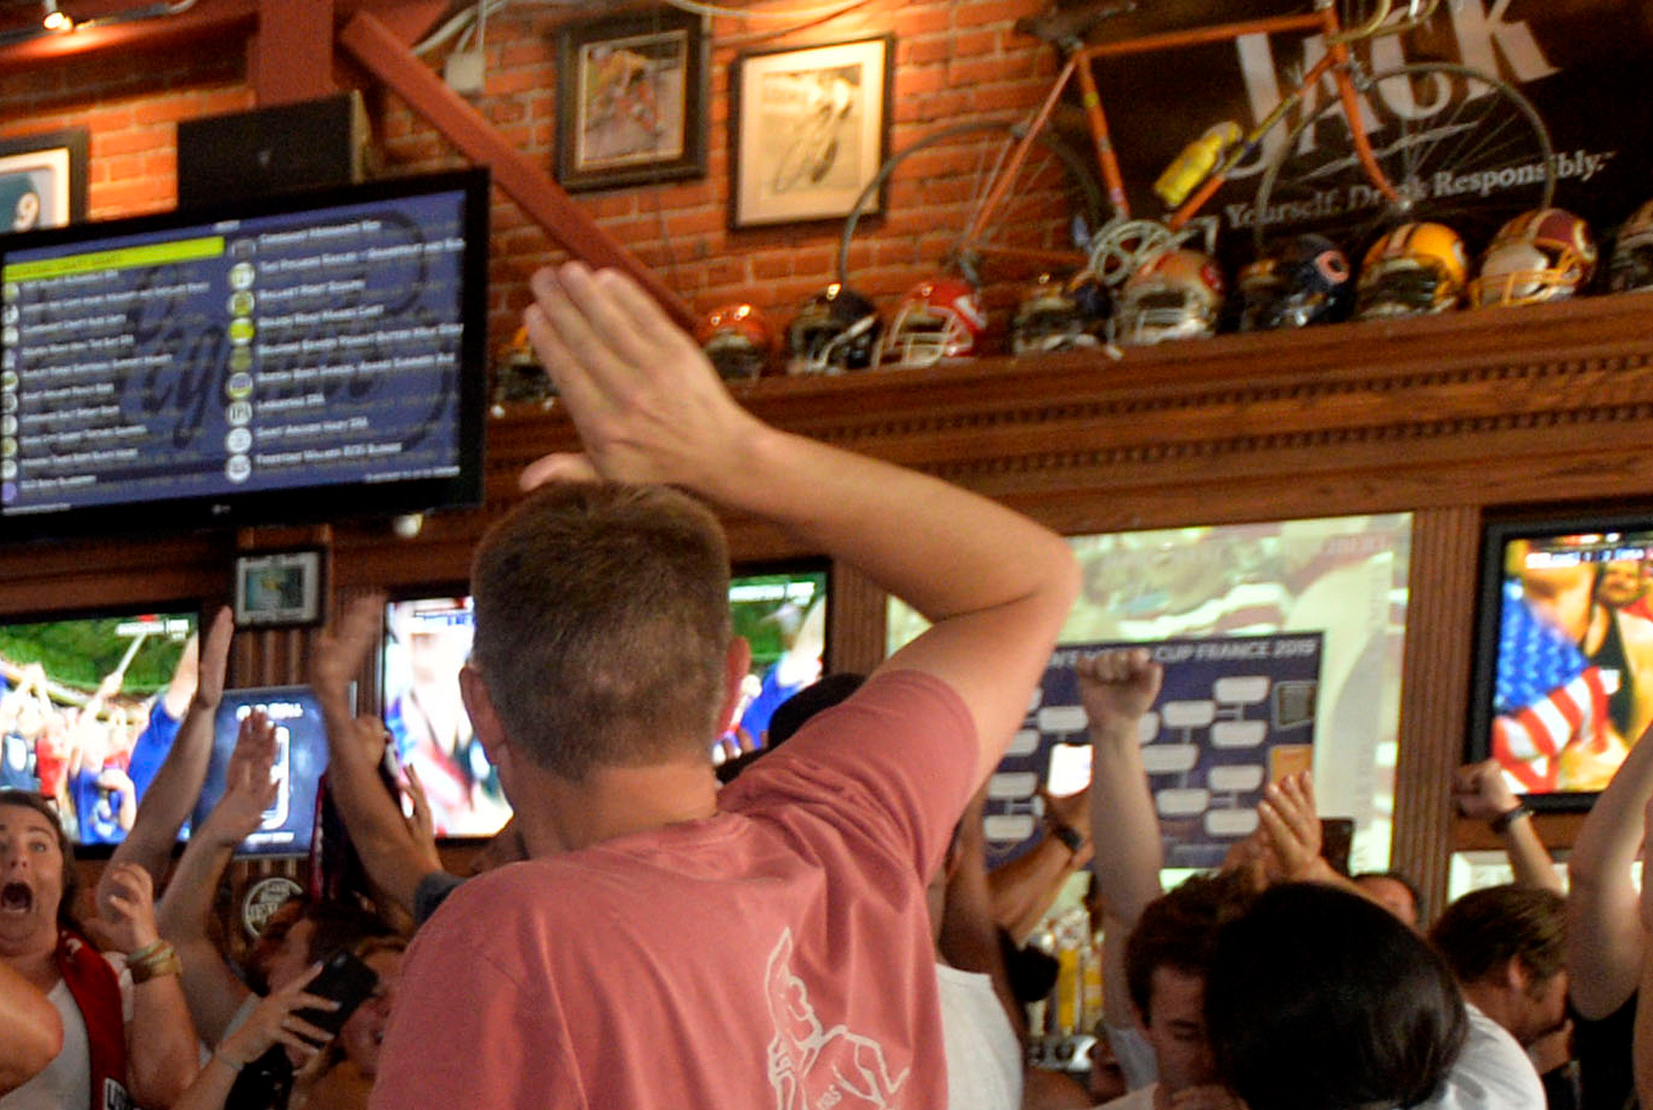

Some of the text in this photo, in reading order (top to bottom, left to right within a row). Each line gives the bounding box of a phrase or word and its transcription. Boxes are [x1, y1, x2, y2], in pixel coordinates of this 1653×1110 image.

[1223, 0, 1564, 180] JACK
[1348, 174, 1428, 211] Drk
[1154, 636, 1318, 662] CUP FRANCE 2019
